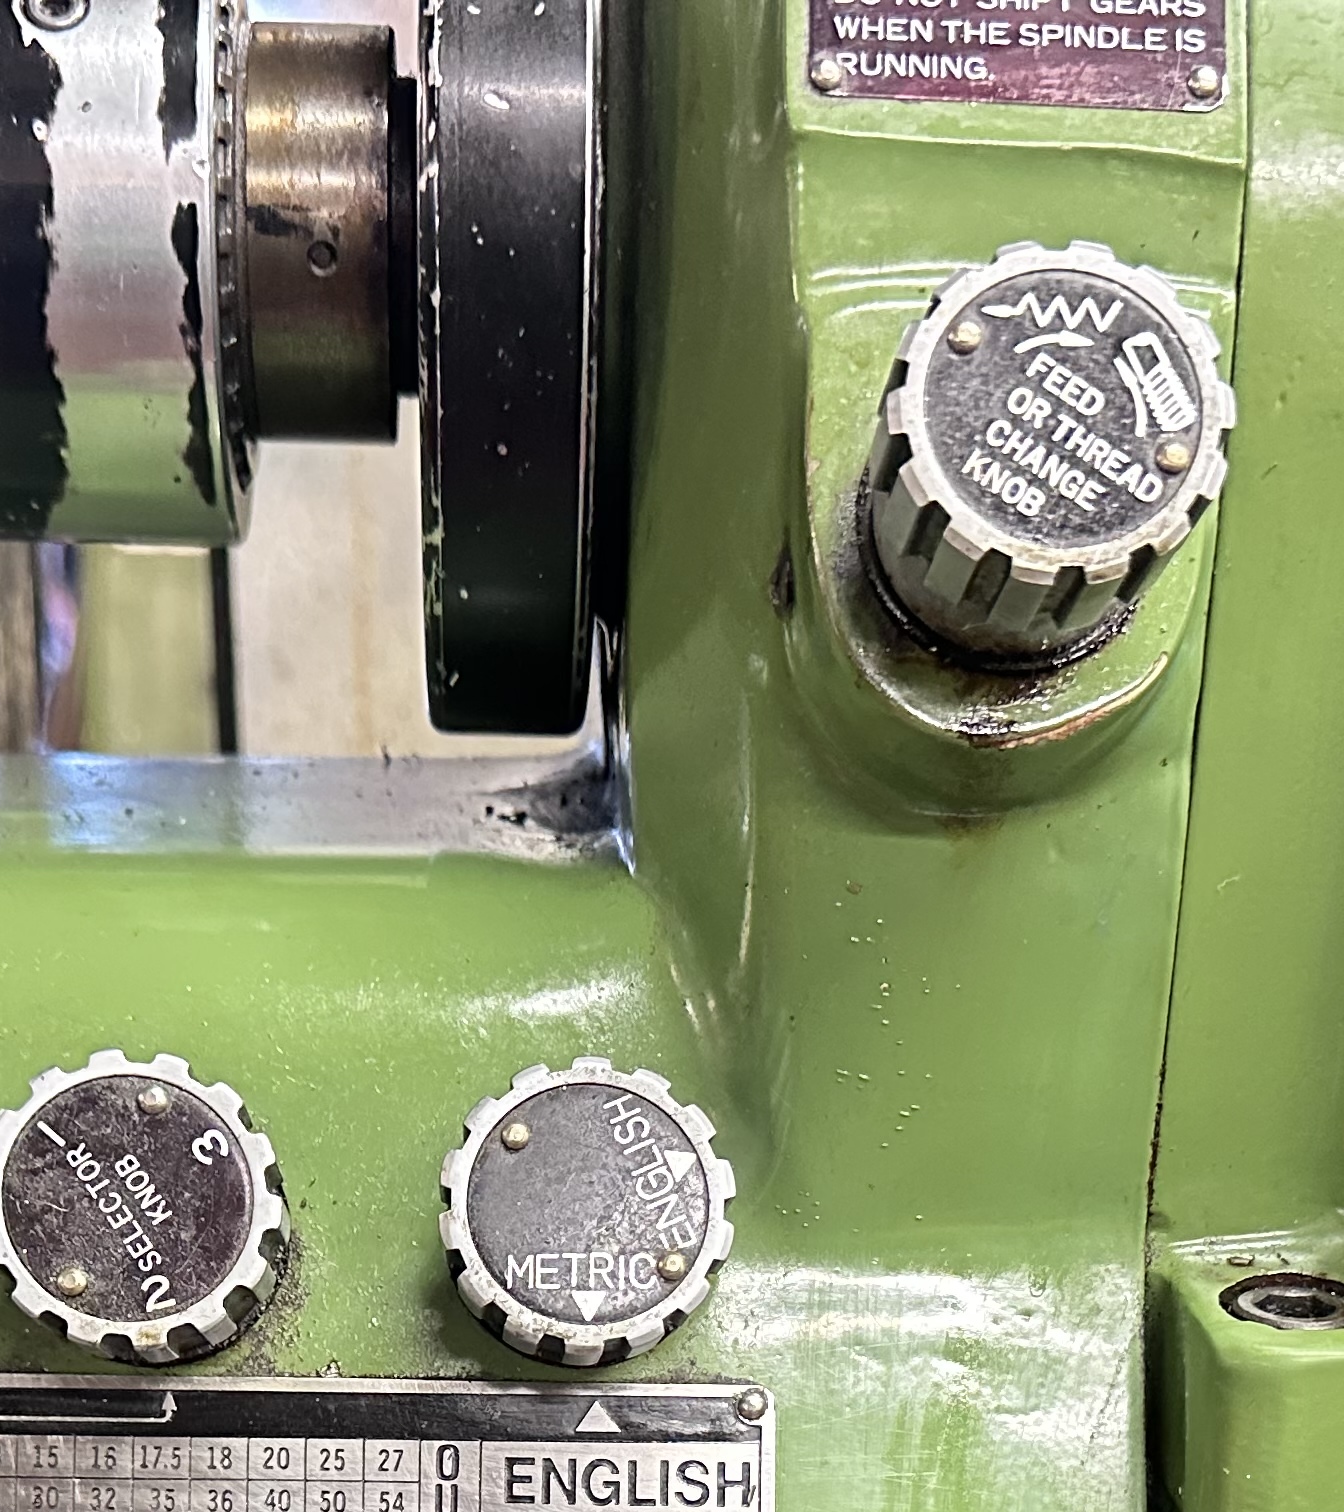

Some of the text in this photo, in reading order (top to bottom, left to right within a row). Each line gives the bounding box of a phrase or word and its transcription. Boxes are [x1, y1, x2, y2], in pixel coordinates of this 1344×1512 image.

[833, 15, 1206, 53] WHEN THE SPINDLE IS
[836, 52, 995, 80] RUNNING.
[1025, 352, 1105, 416] FEED
[986, 420, 1107, 511] CHANGE
[1007, 387, 1164, 503] OR THREAD
[962, 449, 1046, 517] KNOB
[191, 1128, 229, 1165] 3
[603, 1093, 698, 1250] ENGLISH
[66, 1142, 162, 1272] SELECTOR
[115, 1154, 173, 1226] KNOB
[140, 1275, 176, 1313] 2
[506, 1252, 658, 1290] METRIC
[33, 1444, 58, 1468] 15
[91, 1445, 116, 1470] 16
[140, 1446, 181, 1469] 17.5
[207, 1446, 233, 1469] 18
[263, 1447, 290, 1470] 20
[320, 1448, 345, 1471] 25
[378, 1449, 404, 1472] 27
[504, 1456, 751, 1508] ENGLISH
[32, 1486, 59, 1509] 30
[90, 1487, 116, 1511] 32
[150, 1488, 175, 1512] 35
[207, 1489, 233, 1512] 36
[264, 1489, 291, 1512] 40
[320, 1490, 346, 1512] 50
